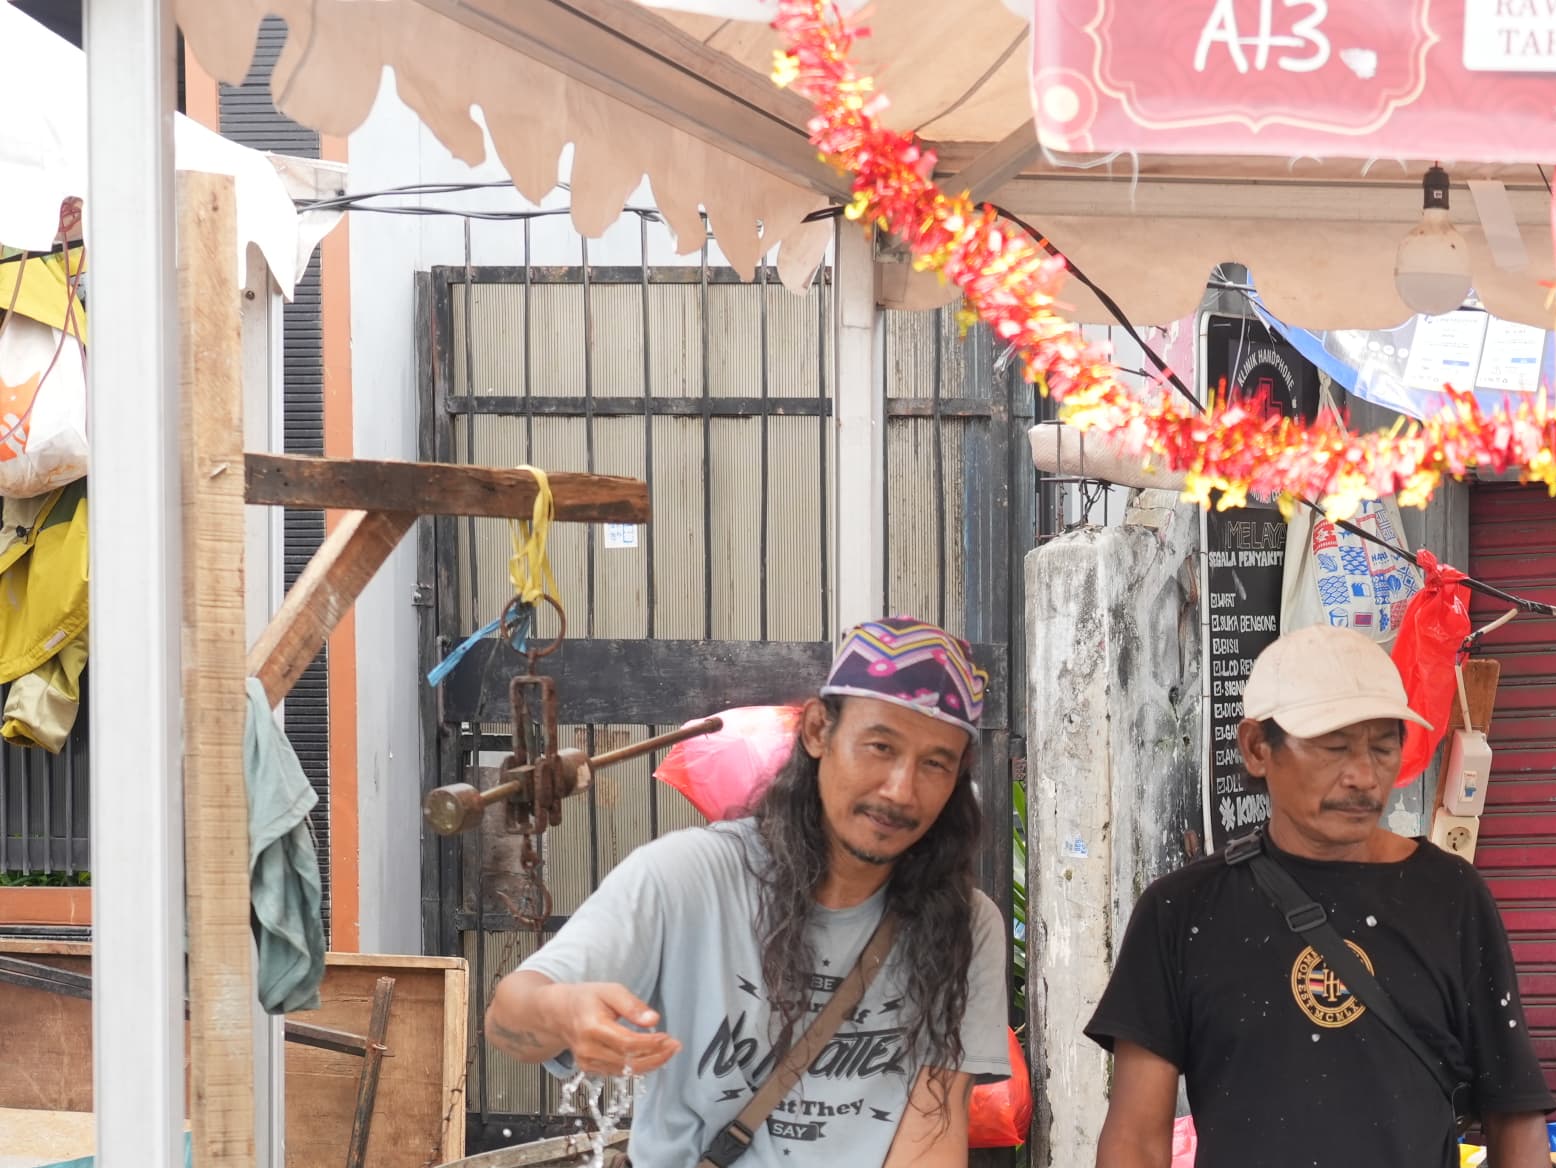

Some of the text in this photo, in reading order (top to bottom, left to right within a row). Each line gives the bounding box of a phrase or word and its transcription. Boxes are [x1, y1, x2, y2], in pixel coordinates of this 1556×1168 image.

[1237, 348, 1295, 392] KLINIK HANDPHONE
[1208, 550, 1284, 568] SEGALA PENYAKIT
[1240, 614, 1277, 633] BENGONG
[800, 1097, 865, 1117] They
[772, 1122, 808, 1138] SAY
